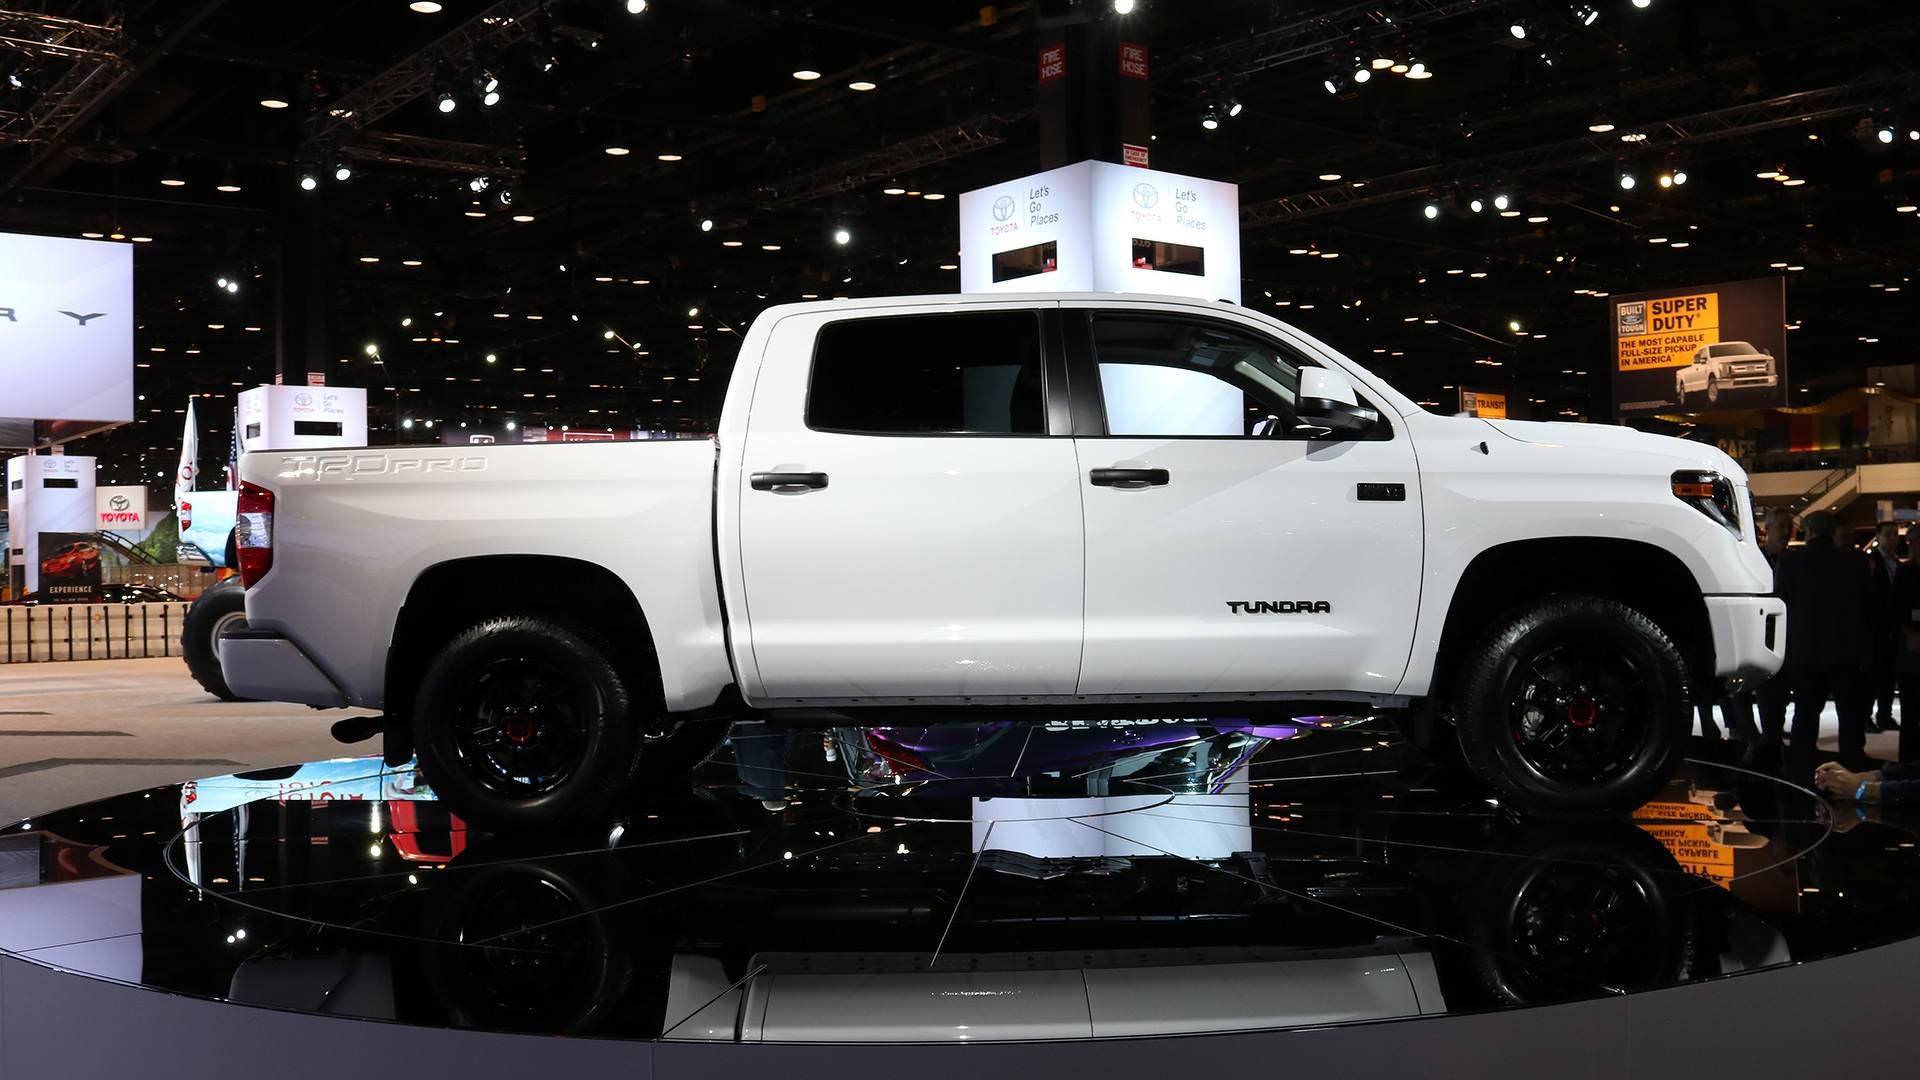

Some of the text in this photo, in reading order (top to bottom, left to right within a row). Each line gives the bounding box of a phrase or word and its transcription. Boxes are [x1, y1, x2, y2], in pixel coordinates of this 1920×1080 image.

[1043, 49, 1060, 64] FIRE
[1123, 46, 1143, 61] FIRE
[1042, 62, 1062, 78] HOSE
[1123, 60, 1145, 75] HOSE
[1030, 185, 1049, 200] Let's
[1176, 187, 1197, 202] Let's
[1030, 201, 1041, 213] Go
[1176, 201, 1188, 213] Go
[1031, 213, 1059, 228] Places
[1176, 215, 1207, 231] Places
[991, 222, 1019, 236] TOYOTA
[1621, 305, 1643, 316] BUILT
[1651, 297, 1707, 315] SUPER
[1621, 323, 1644, 333] TOUGH
[1621, 334, 1705, 349] THE MOST CAPABLE
[1621, 344, 1697, 358] FULL-SIZE PICKUP
[1621, 354, 1672, 366] IN AMERICA
[1477, 399, 1505, 410] TRANSIT
[100, 512, 140, 523] TOYOTA
[49, 585, 92, 594] EXPERIENCE
[1226, 601, 1331, 614] TUNDRA
